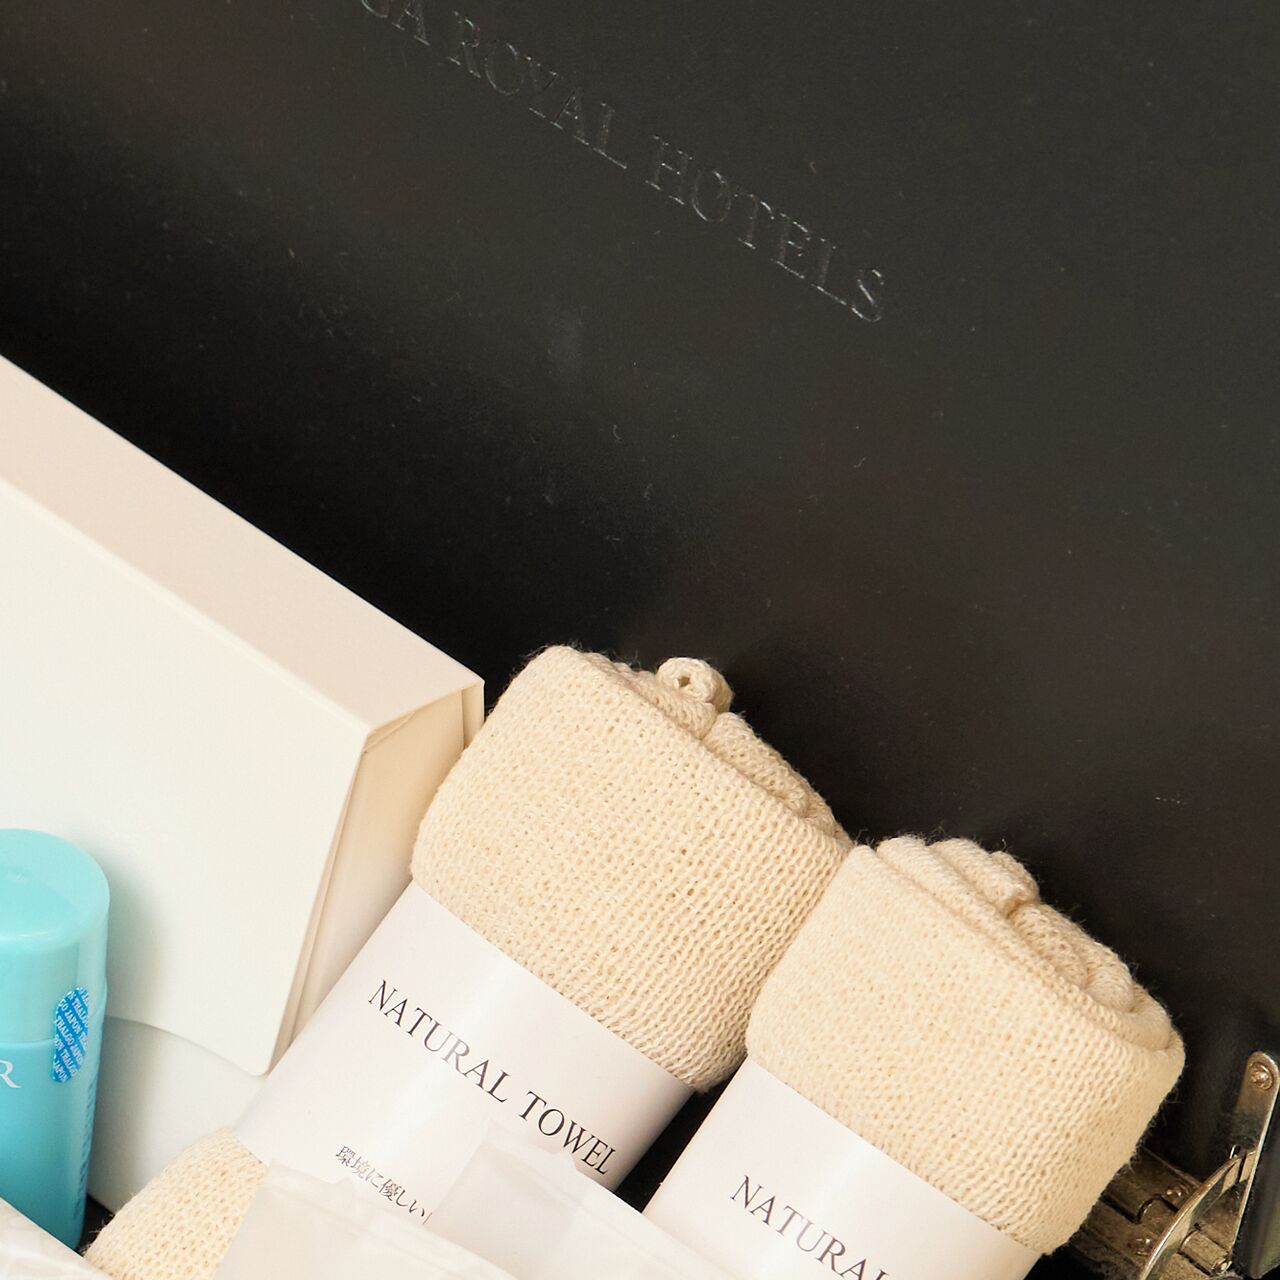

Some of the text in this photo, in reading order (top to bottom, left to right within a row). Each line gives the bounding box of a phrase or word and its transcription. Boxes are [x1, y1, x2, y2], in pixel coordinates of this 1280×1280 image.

[444, 8, 628, 170] ROYAL
[643, 133, 885, 323] HOTELS
[367, 978, 617, 1176] NATURAL TOWEL
[335, 1144, 433, 1226] 環境に優しい
